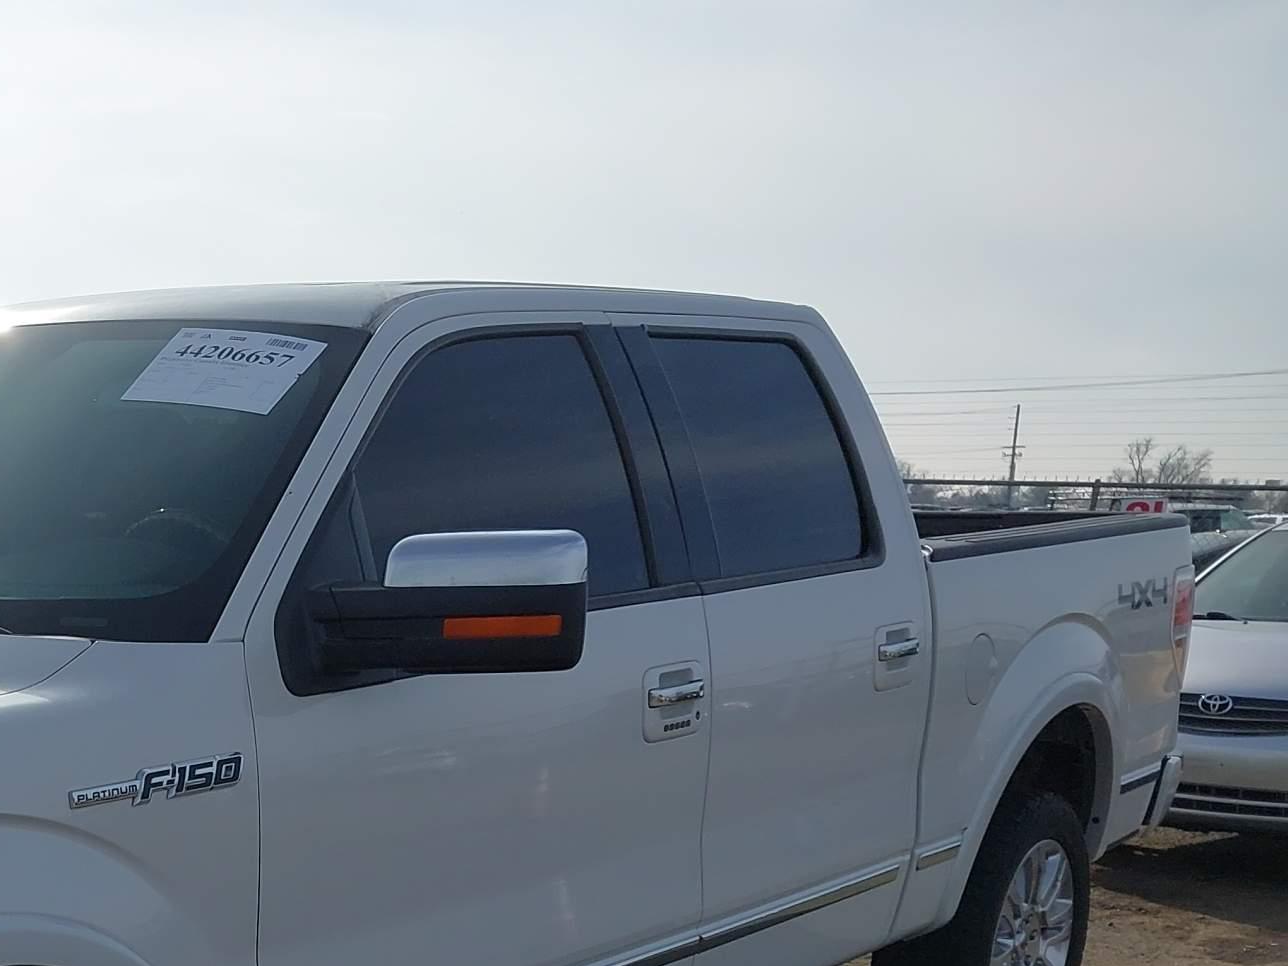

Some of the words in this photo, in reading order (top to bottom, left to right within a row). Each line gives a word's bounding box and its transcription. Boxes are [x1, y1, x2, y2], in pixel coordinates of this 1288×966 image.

[176, 343, 296, 368] 44206657
[76, 784, 138, 803] PLATINUM
[139, 754, 243, 802] F-150
